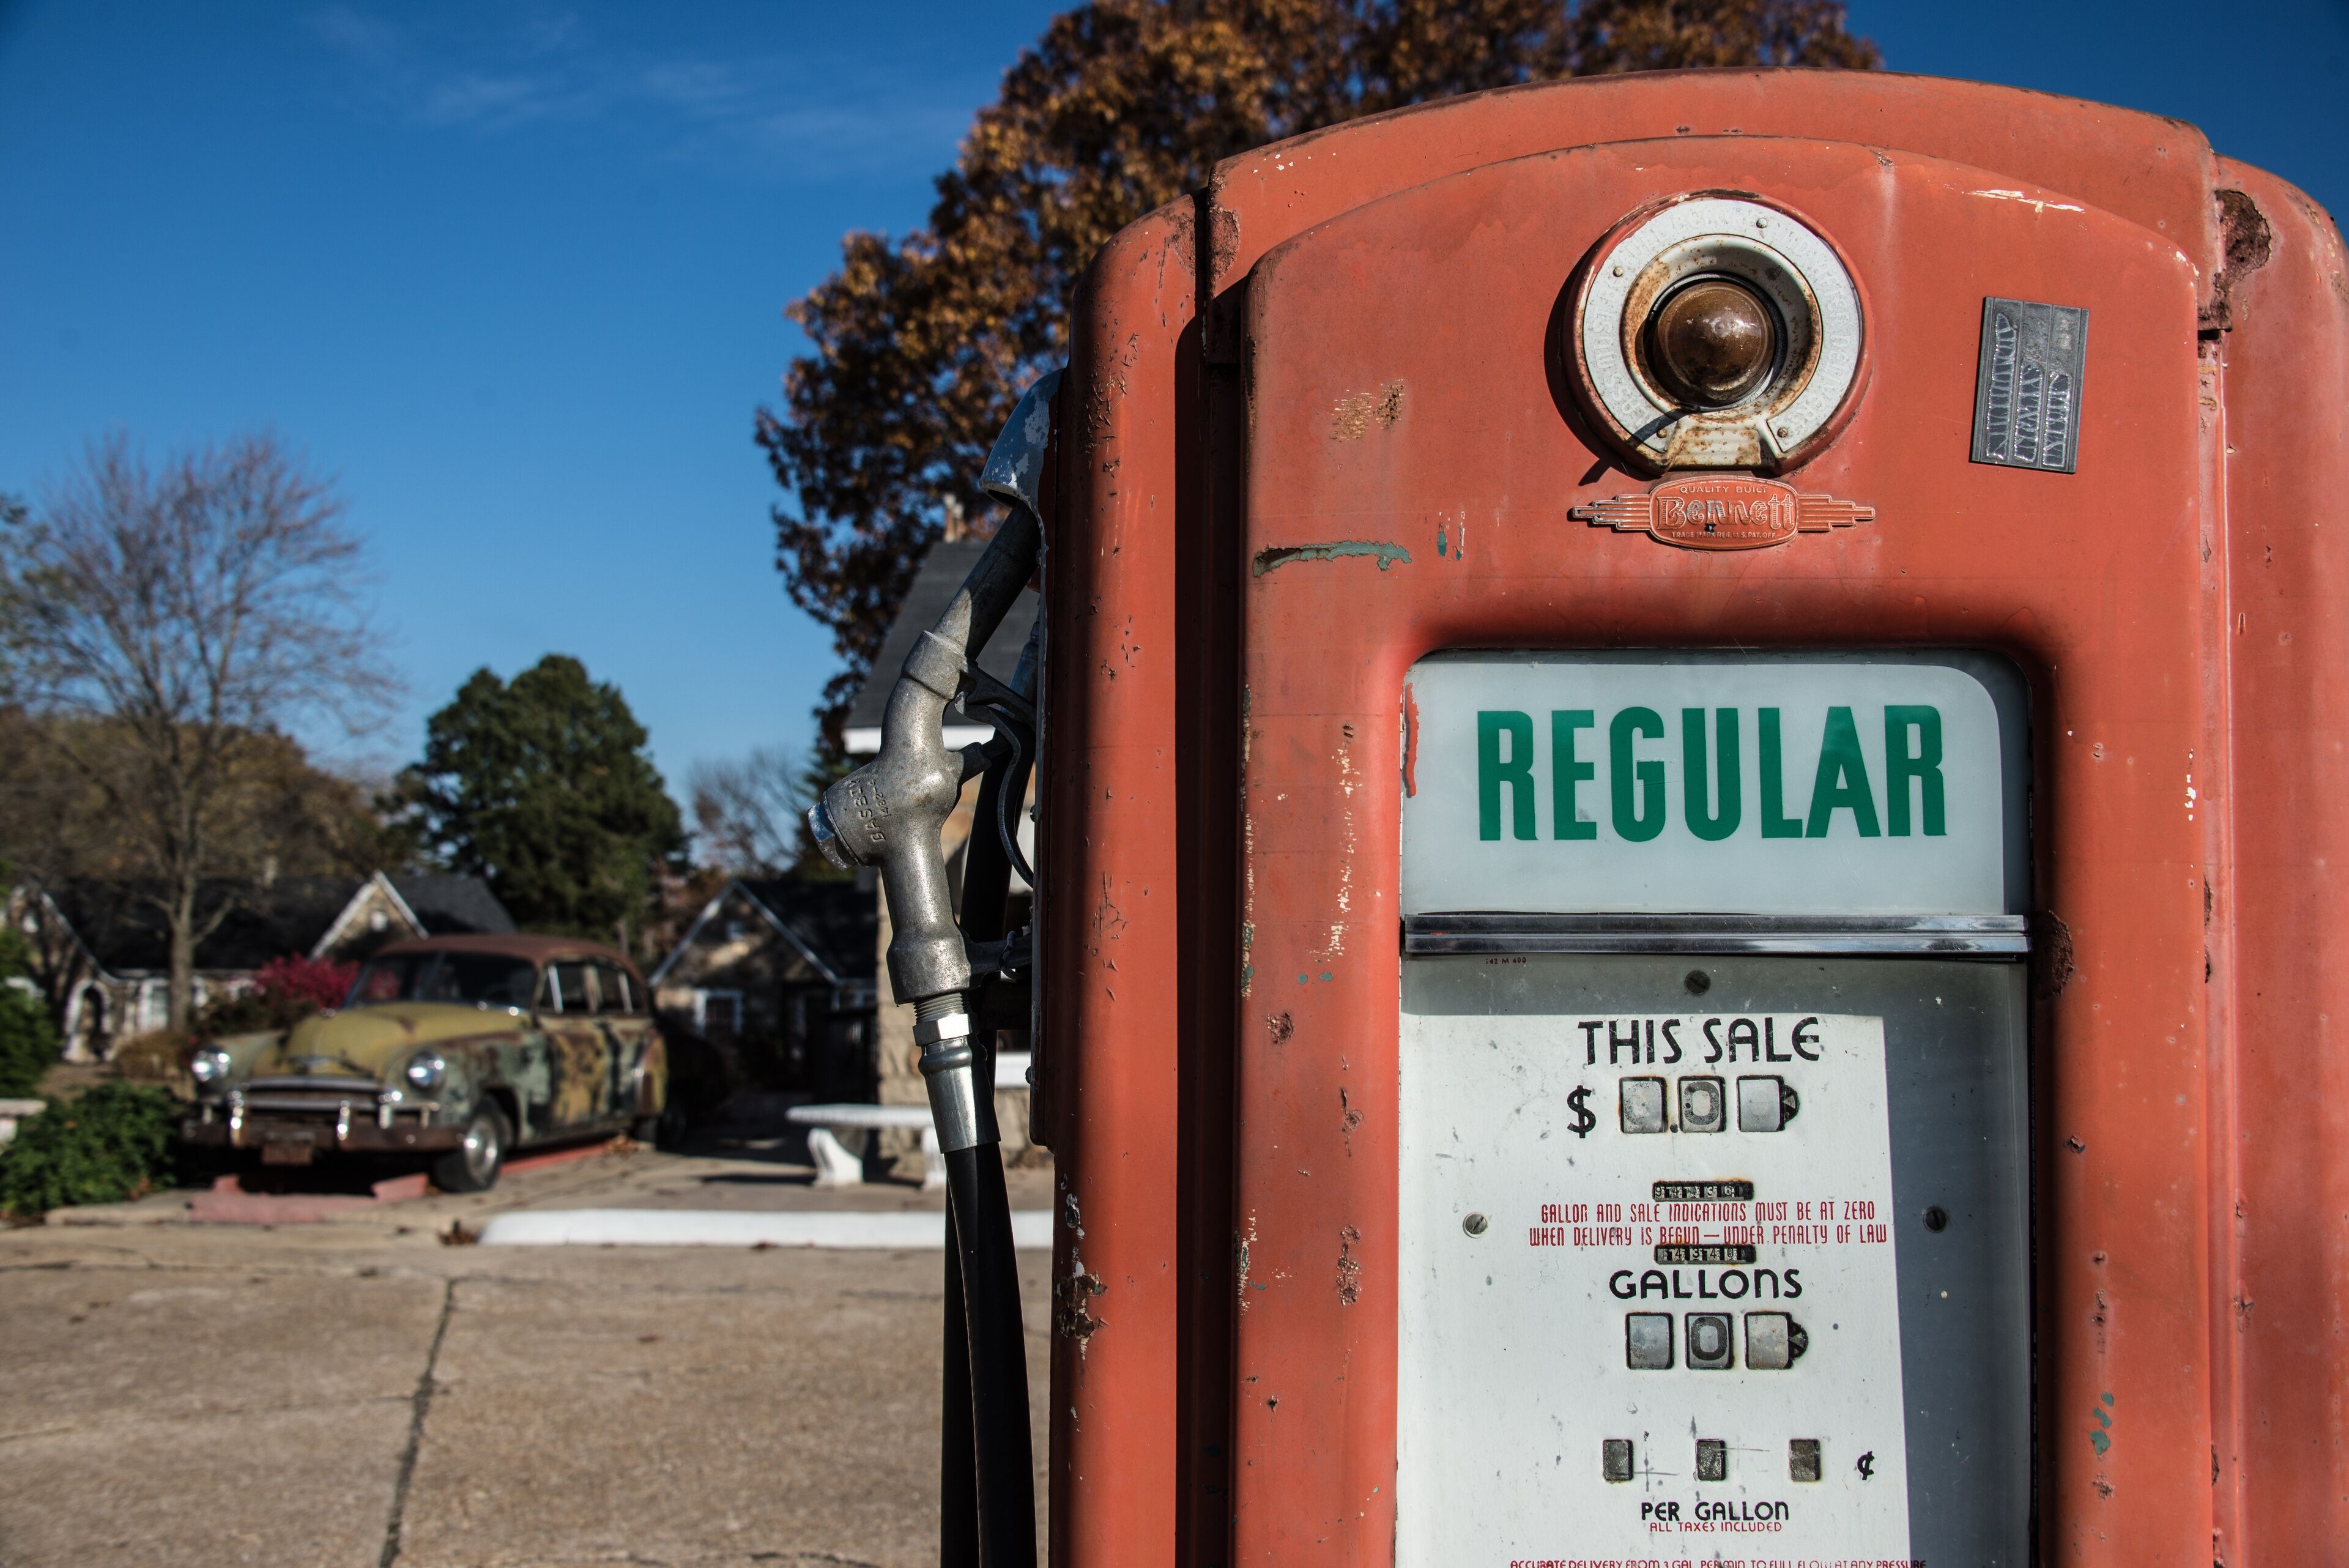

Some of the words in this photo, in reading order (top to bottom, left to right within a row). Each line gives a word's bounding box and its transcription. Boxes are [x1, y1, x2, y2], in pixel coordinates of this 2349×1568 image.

[1657, 493, 1794, 530] Bennett
[1477, 705, 1948, 842] REGULAR
[1578, 1019, 1683, 1066] THIS
[1702, 1017, 1820, 1064] SALE
[1567, 1085, 1597, 1139] $
[1541, 1204, 1588, 1224] GALLON
[1597, 1203, 1622, 1223] AND
[1630, 1203, 1660, 1222] SALE
[1669, 1203, 1746, 1222] INDICATIONS
[1756, 1202, 1788, 1222] MUST
[1797, 1202, 1811, 1221] BE
[1820, 1202, 1835, 1221] AT
[1844, 1201, 1875, 1221] ZERO
[1529, 1227, 1565, 1246] WHEN
[1574, 1227, 1632, 1246] DELIVERY
[1641, 1226, 1652, 1246] IS
[1660, 1226, 1699, 1245] BEGUN
[1723, 1225, 1764, 1244] UNDER
[1773, 1225, 1828, 1244] PENALTY
[1837, 1224, 1851, 1243] OF
[1860, 1224, 1887, 1243] LAW
[1609, 1269, 1803, 1299] GALLONS
[1857, 1451, 1875, 1481] ¢
[1641, 1502, 1680, 1522] PER
[1695, 1501, 1789, 1522] GALLON
[1650, 1522, 1672, 1533] ALL
[1678, 1522, 1715, 1532] TAXES
[1721, 1522, 1783, 1533] INCLUDED
